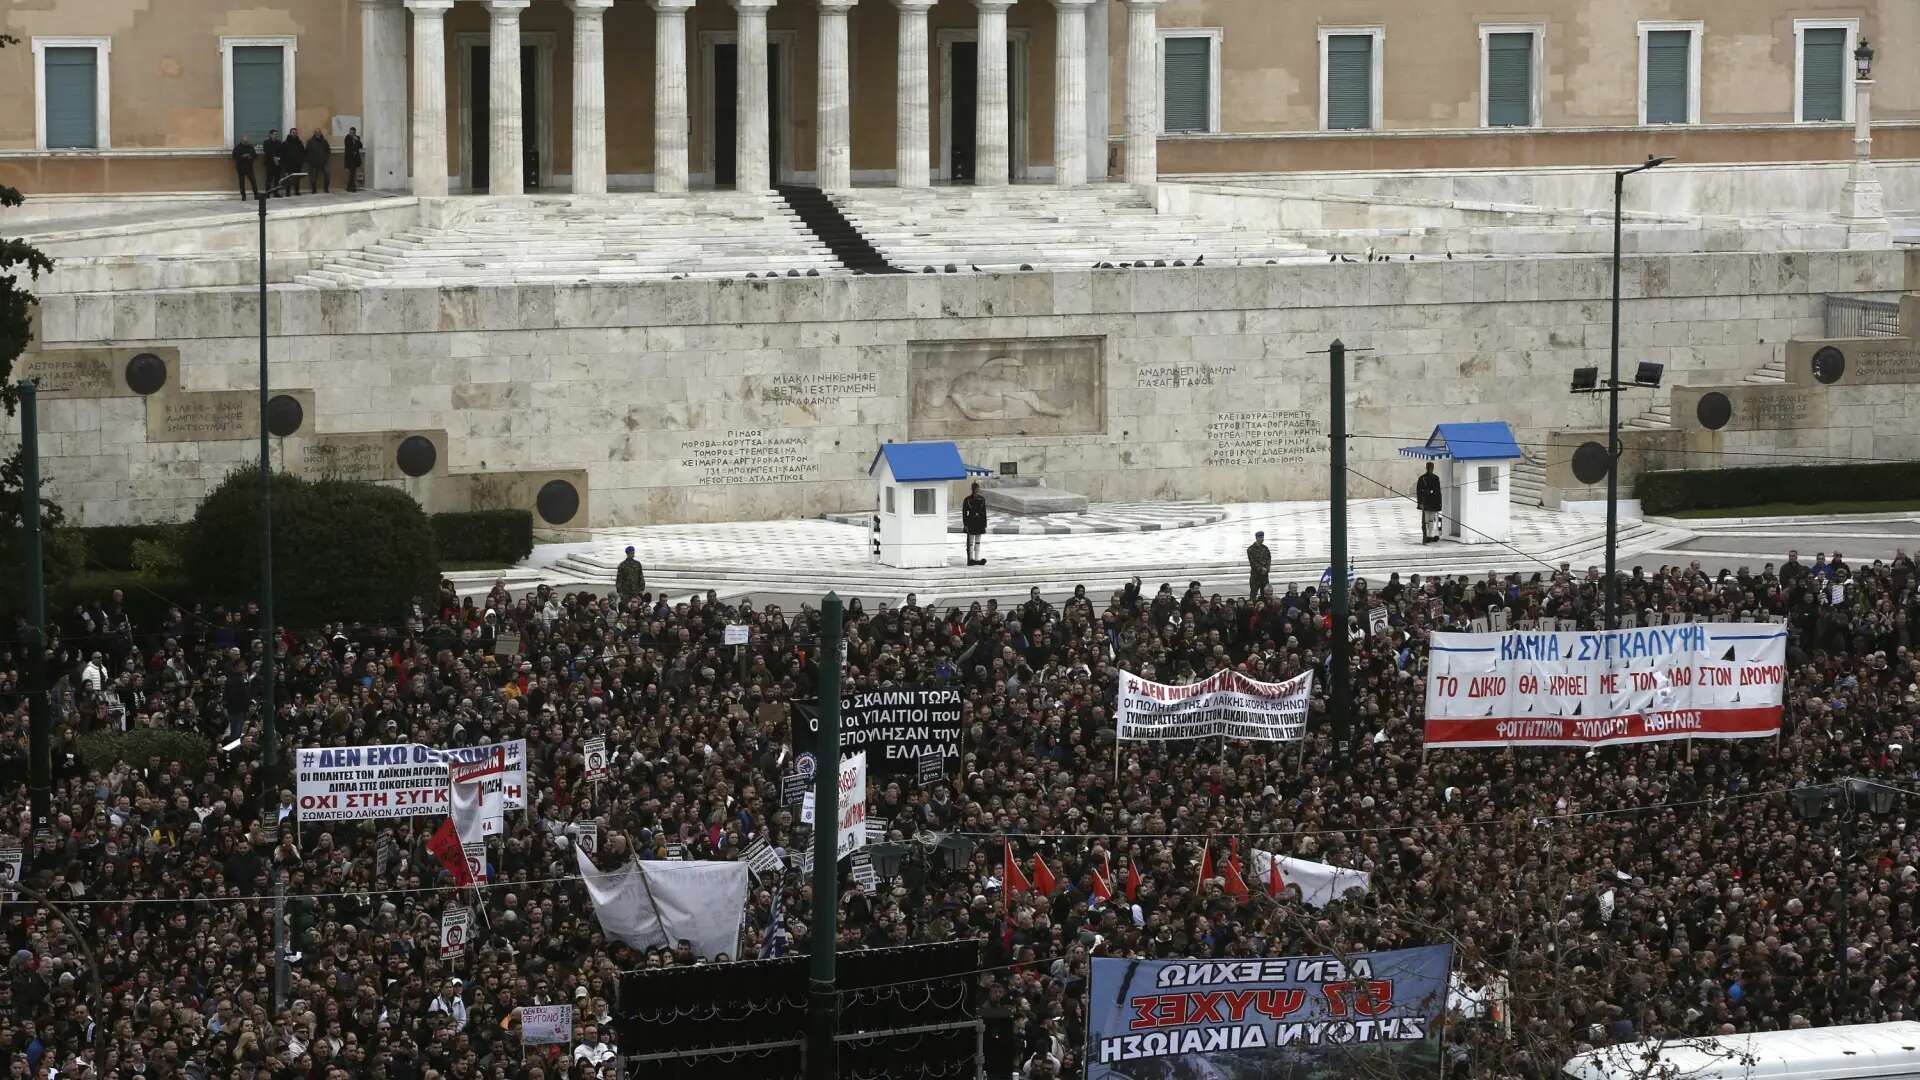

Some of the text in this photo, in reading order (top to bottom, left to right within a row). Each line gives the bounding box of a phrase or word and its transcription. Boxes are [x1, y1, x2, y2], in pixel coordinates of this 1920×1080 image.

[1501, 625, 1704, 661] ΚΑΜΙΑ ΣΥΓΚΑΛΥΨΗ
[1436, 676, 1458, 697] ΤΟ
[1468, 677, 1506, 698] ΔΙΚΙΟ
[1519, 675, 1538, 694] ΘΑ
[1600, 674, 1619, 695] ΜΕ
[1630, 671, 1657, 691] ΤΟΝ
[1698, 666, 1732, 686] ΣΤΟΝ
[854, 691, 914, 708] ΣΚΑΜΝΙ
[919, 690, 961, 704] ΤΩΡΑ
[1141, 681, 1165, 701] ΔΕΝ
[1123, 698, 1134, 708] ΟΙ
[1136, 700, 1181, 712] ΠΩΛΗΤΕΣ
[1184, 699, 1201, 710] ΤΗΣ
[862, 709, 928, 724] ΥΠΑΙΤΙΟΙ
[932, 710, 960, 721] που
[1127, 710, 1204, 725] ΣΥΜΠΑΡΑΣΤΕΚΟΝΤΑΙ
[1223, 709, 1248, 722] ΔΙΚΑΙΟ
[1496, 711, 1702, 738] ΦΟΙΤΗΤΙΚΟΙ ΣΥΛΛΟΓΟΙ ΑΘΗΝΑΣ
[840, 727, 960, 746] ΕΠΟΥΛΗΣΑΝ την
[319, 749, 361, 768] ΔΕΝ
[367, 746, 408, 765] ΕΧΩ
[301, 772, 311, 782] ΟΙ
[313, 771, 355, 781] ΠΩΛΗΤΕΣ
[356, 770, 374, 780] ΤΩΝ
[378, 767, 411, 778] ΛΑΪΚΩΝ
[413, 766, 448, 776] ΑΓΟΡΩΝ
[329, 782, 358, 792] ΔΙΠΛΑ
[359, 782, 377, 791] ΣΤΙΣ
[379, 779, 433, 791] ΟΙΚΟΓΕΝΕΙΕΣ
[300, 795, 338, 809] ΟΧΙ
[346, 792, 388, 808] ΣΤΗ
[302, 811, 353, 820] ΣΩΜΑΤΕΙΟ
[355, 807, 391, 818] ΛΑΪΚΩΝ
[394, 806, 433, 816] ΑΓΟΡΩΝ
